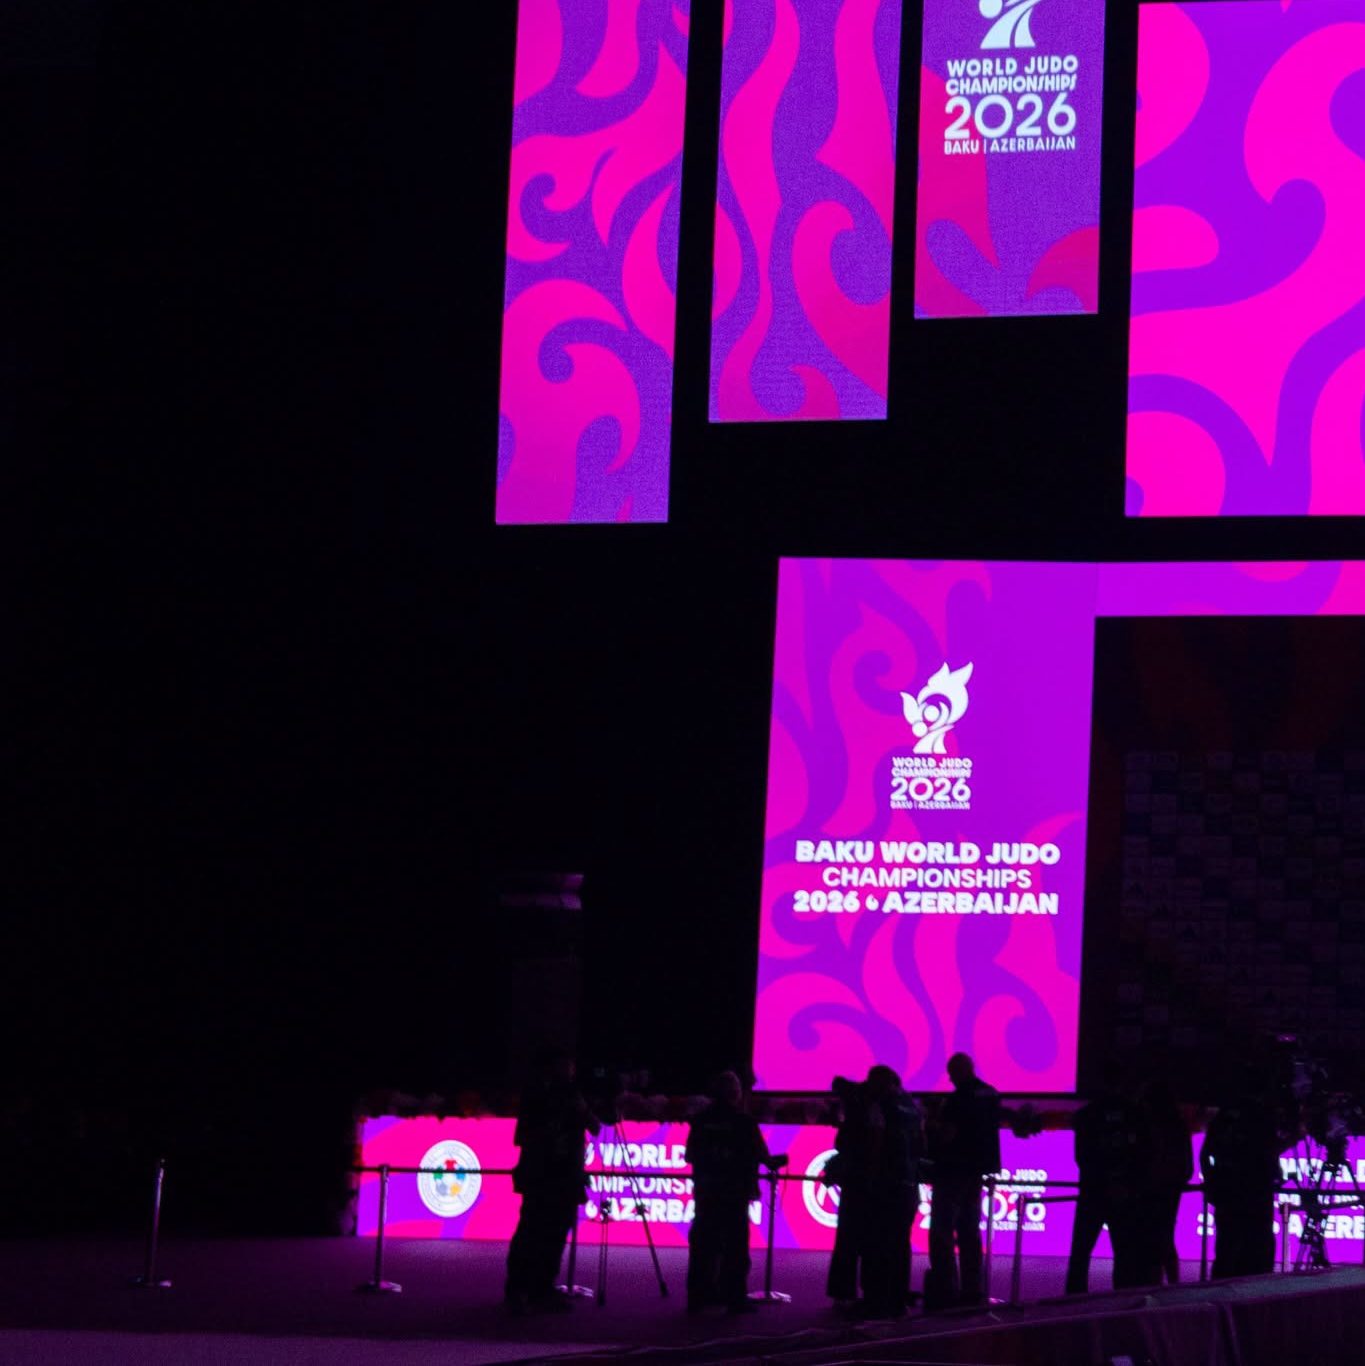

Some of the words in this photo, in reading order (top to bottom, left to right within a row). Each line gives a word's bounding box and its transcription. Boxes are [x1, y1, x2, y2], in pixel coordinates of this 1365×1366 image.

[947, 57, 1018, 77] WORLD
[1024, 54, 1078, 74] JUDO
[945, 74, 1077, 96] CHAMPIONSHIPS
[944, 92, 1077, 139] 2026
[944, 138, 980, 155] BAKU
[990, 136, 1076, 153] AZERBAIJAN
[892, 756, 937, 769] WORLD
[938, 757, 973, 769] JUDO
[890, 777, 972, 802] 2026
[795, 840, 875, 864] BAKU
[880, 841, 981, 864] WORLD
[985, 842, 1062, 865] JUDO
[822, 866, 1033, 889] CHAMPIONSHIPS
[793, 890, 861, 913] 2026
[882, 891, 1059, 915] AZERBAIJAN
[599, 1142, 687, 1168] WORLD
